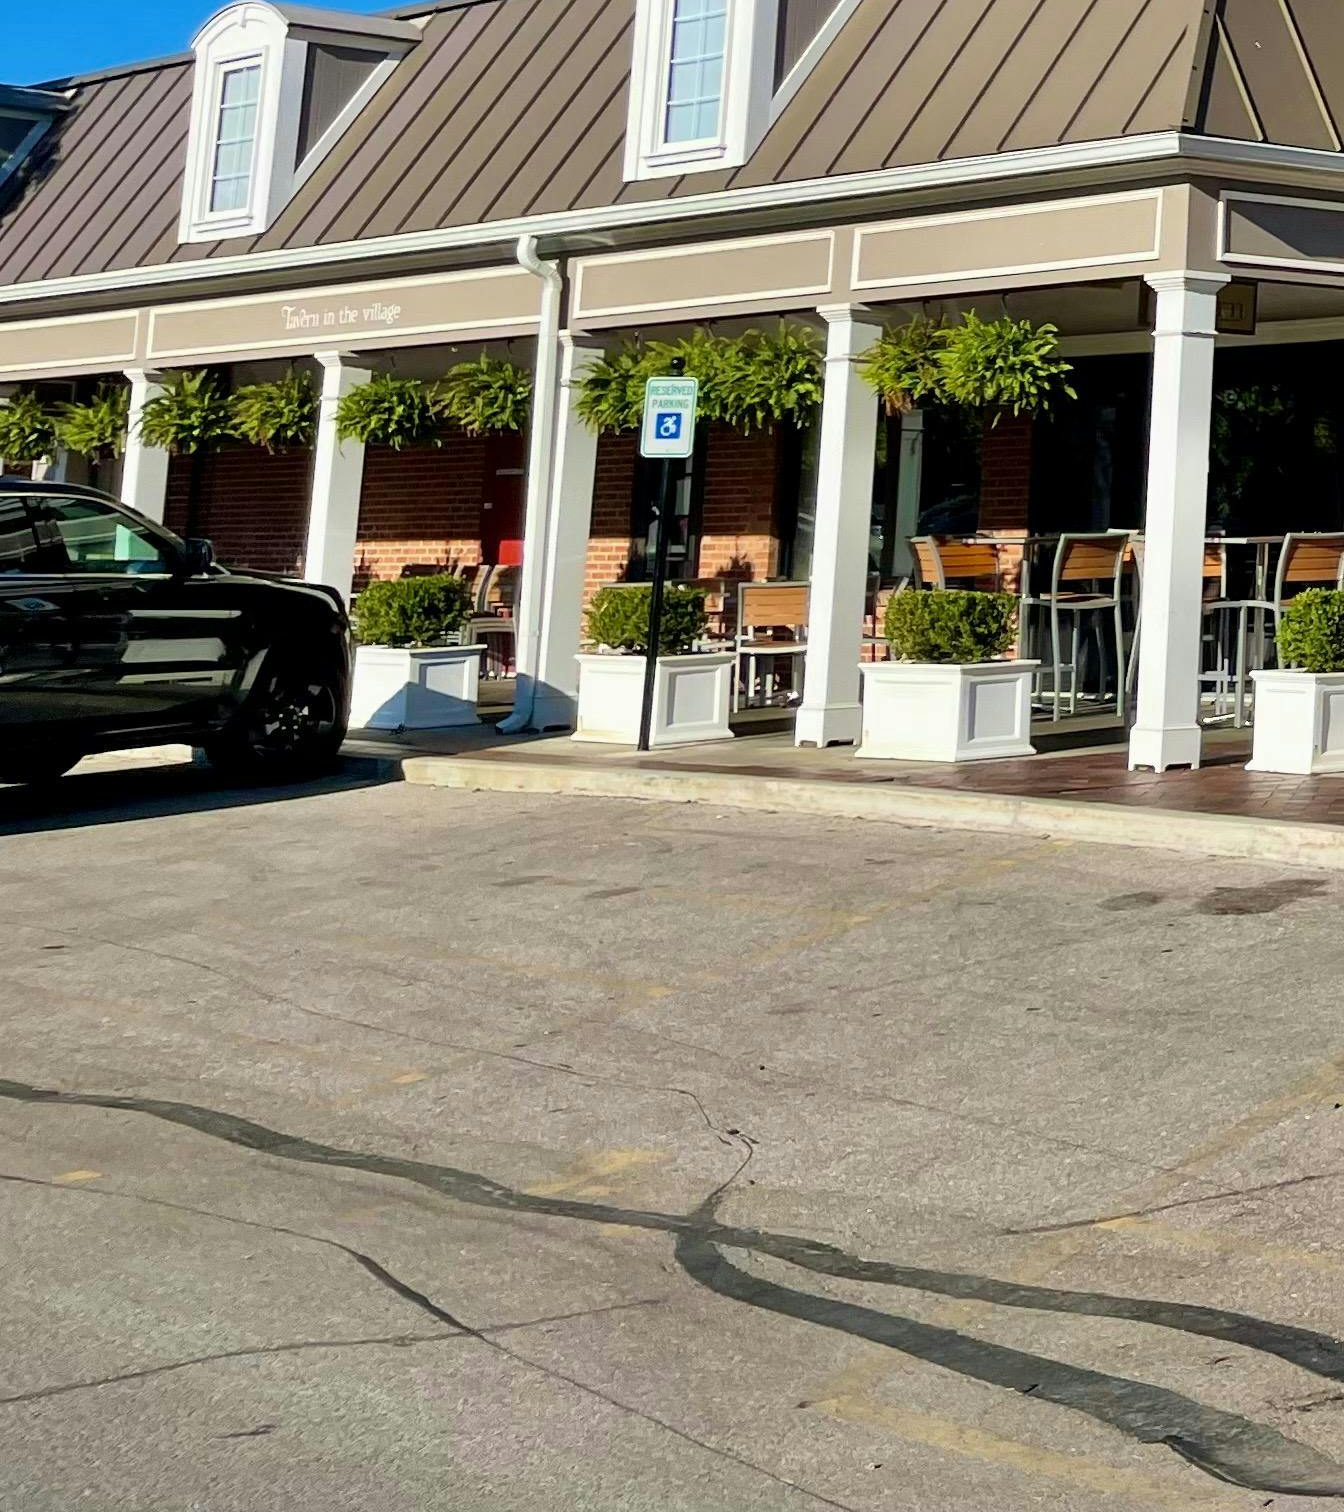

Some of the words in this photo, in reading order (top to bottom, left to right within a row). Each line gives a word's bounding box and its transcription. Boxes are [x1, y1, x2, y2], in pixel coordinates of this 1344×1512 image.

[281, 305, 320, 330] Tavern
[323, 308, 336, 326] in
[339, 305, 359, 324] the
[362, 302, 401, 325] village
[650, 385, 694, 396] RESERVED
[651, 399, 690, 409] PARKING
